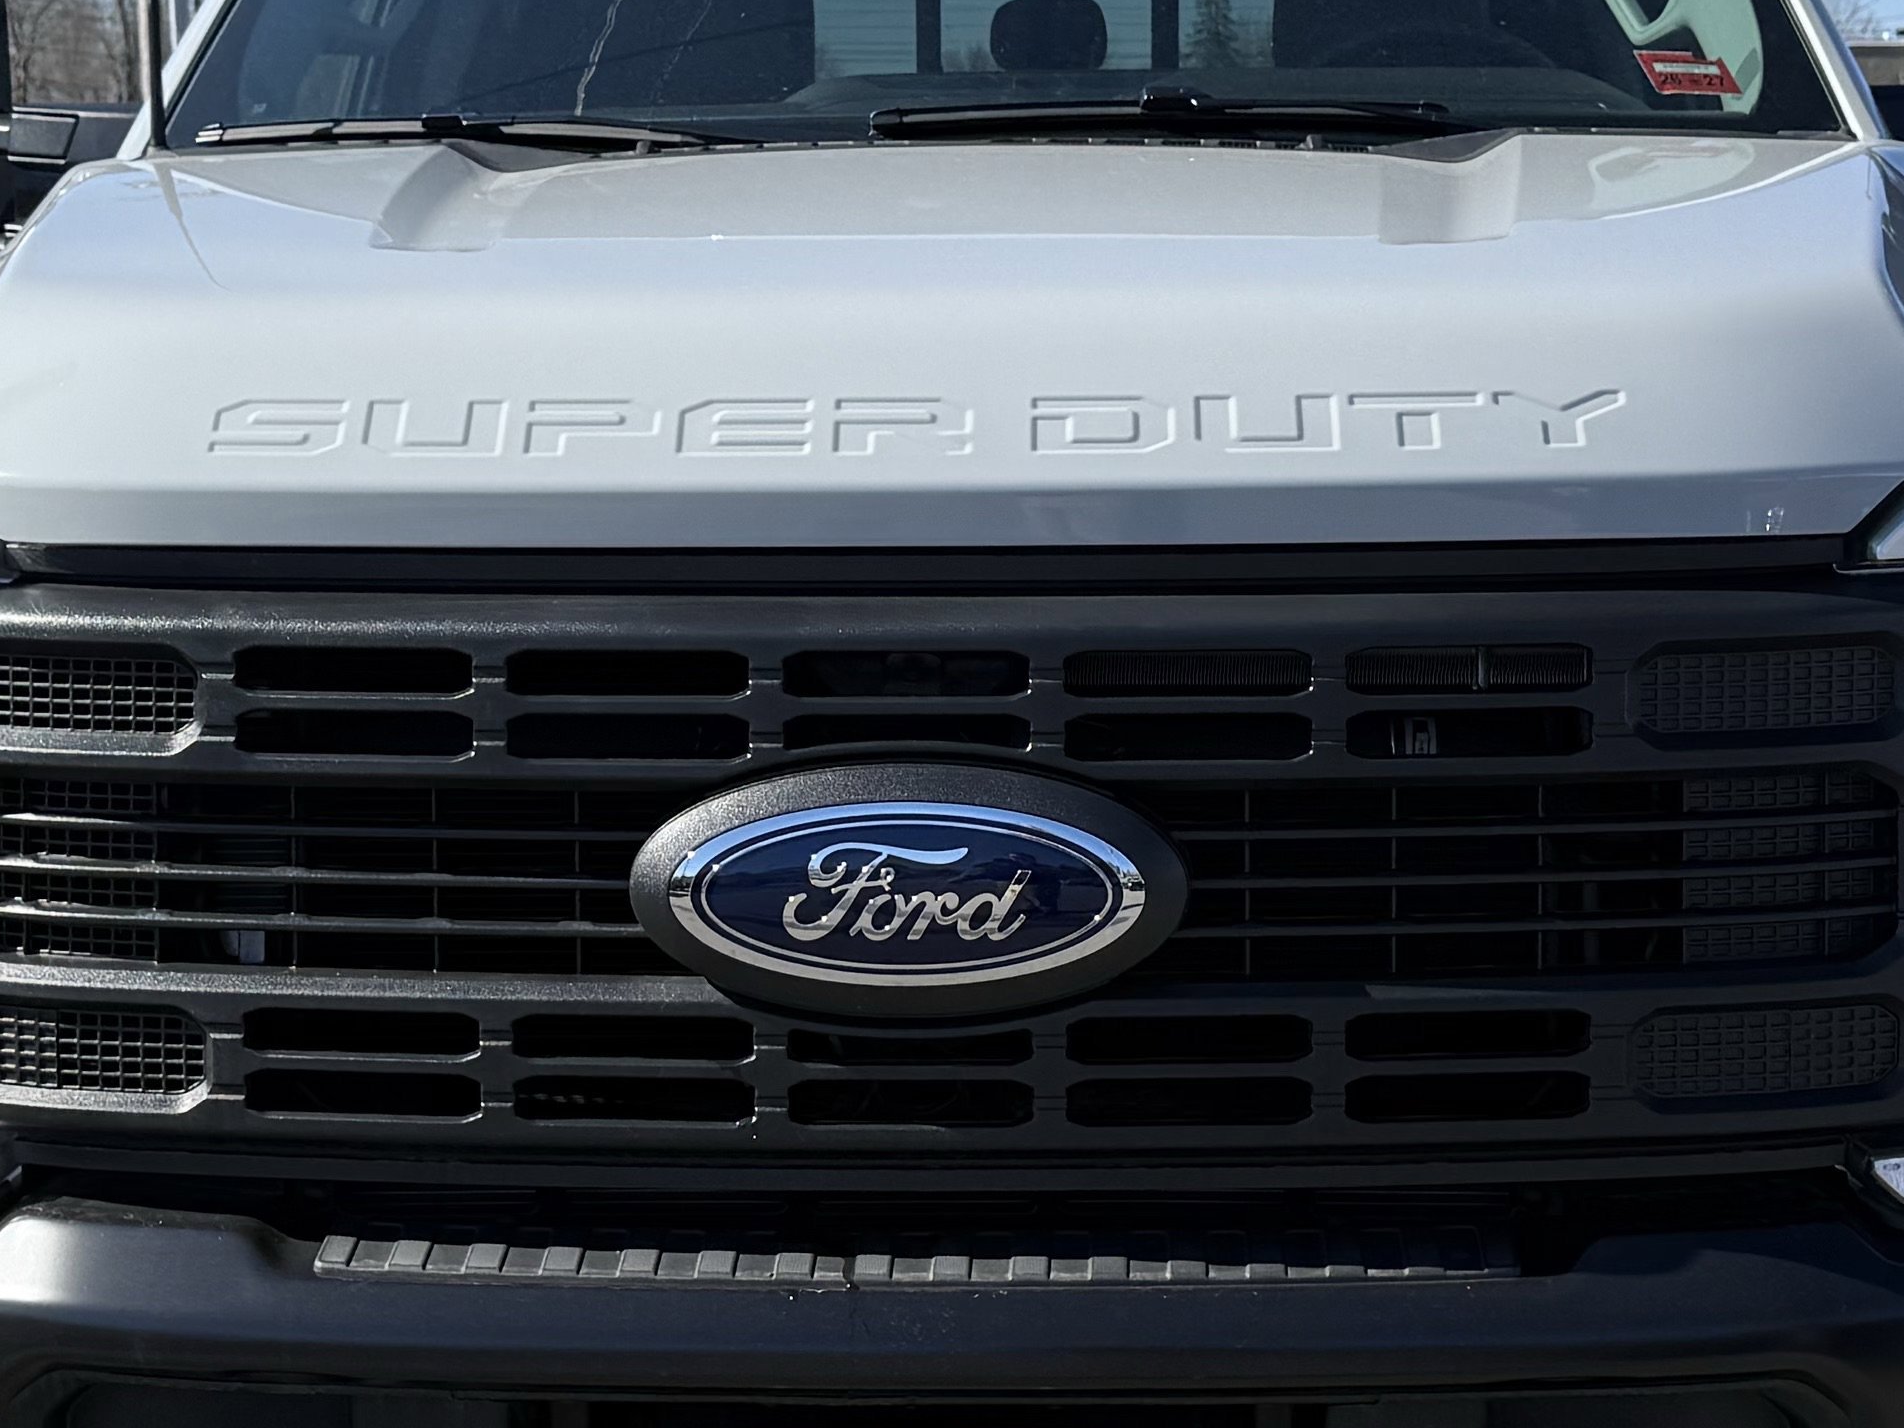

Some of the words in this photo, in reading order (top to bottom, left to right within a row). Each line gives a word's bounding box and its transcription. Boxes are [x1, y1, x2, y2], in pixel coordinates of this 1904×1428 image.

[207, 398, 974, 457] SUPER
[1030, 389, 1626, 454] DUTY
[782, 841, 1032, 942] Ford
